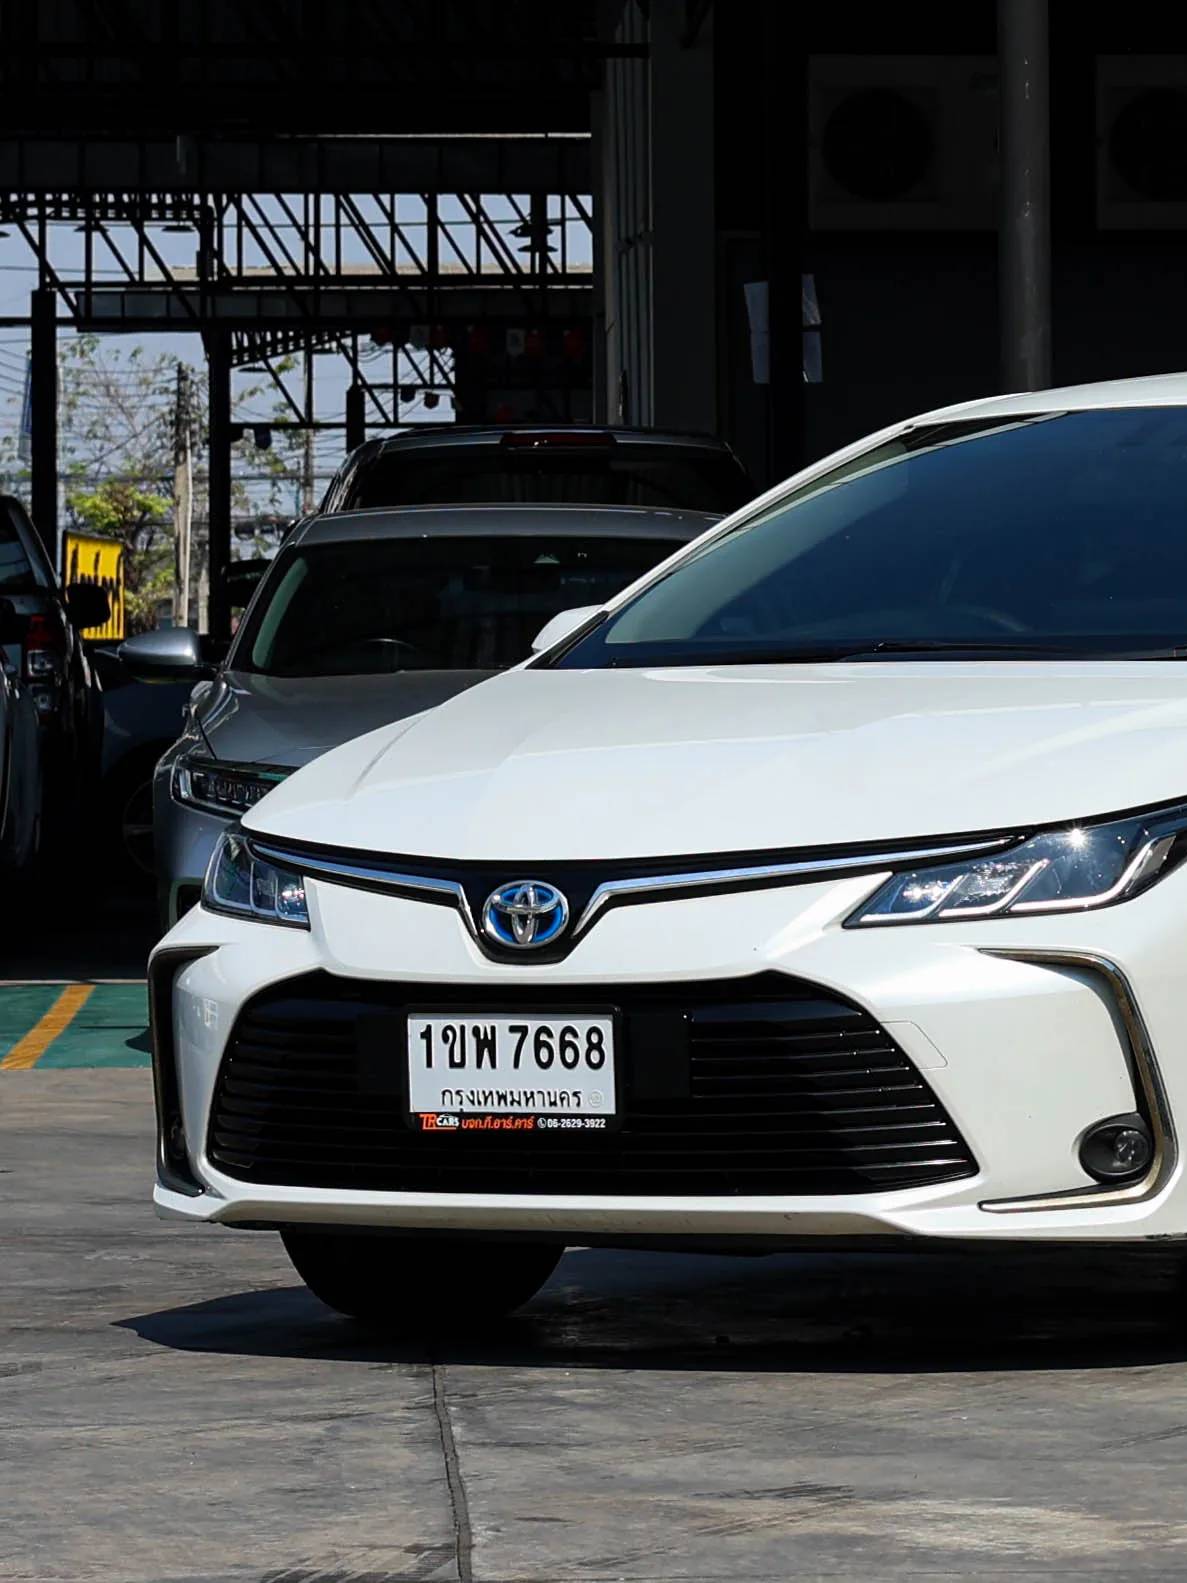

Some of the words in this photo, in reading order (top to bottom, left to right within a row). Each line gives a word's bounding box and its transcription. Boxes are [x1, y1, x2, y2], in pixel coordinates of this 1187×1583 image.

[420, 1024, 497, 1069] 1ขพ
[508, 1025, 606, 1070] 7668
[441, 1088, 582, 1112] กรุงเทพมหานคร
